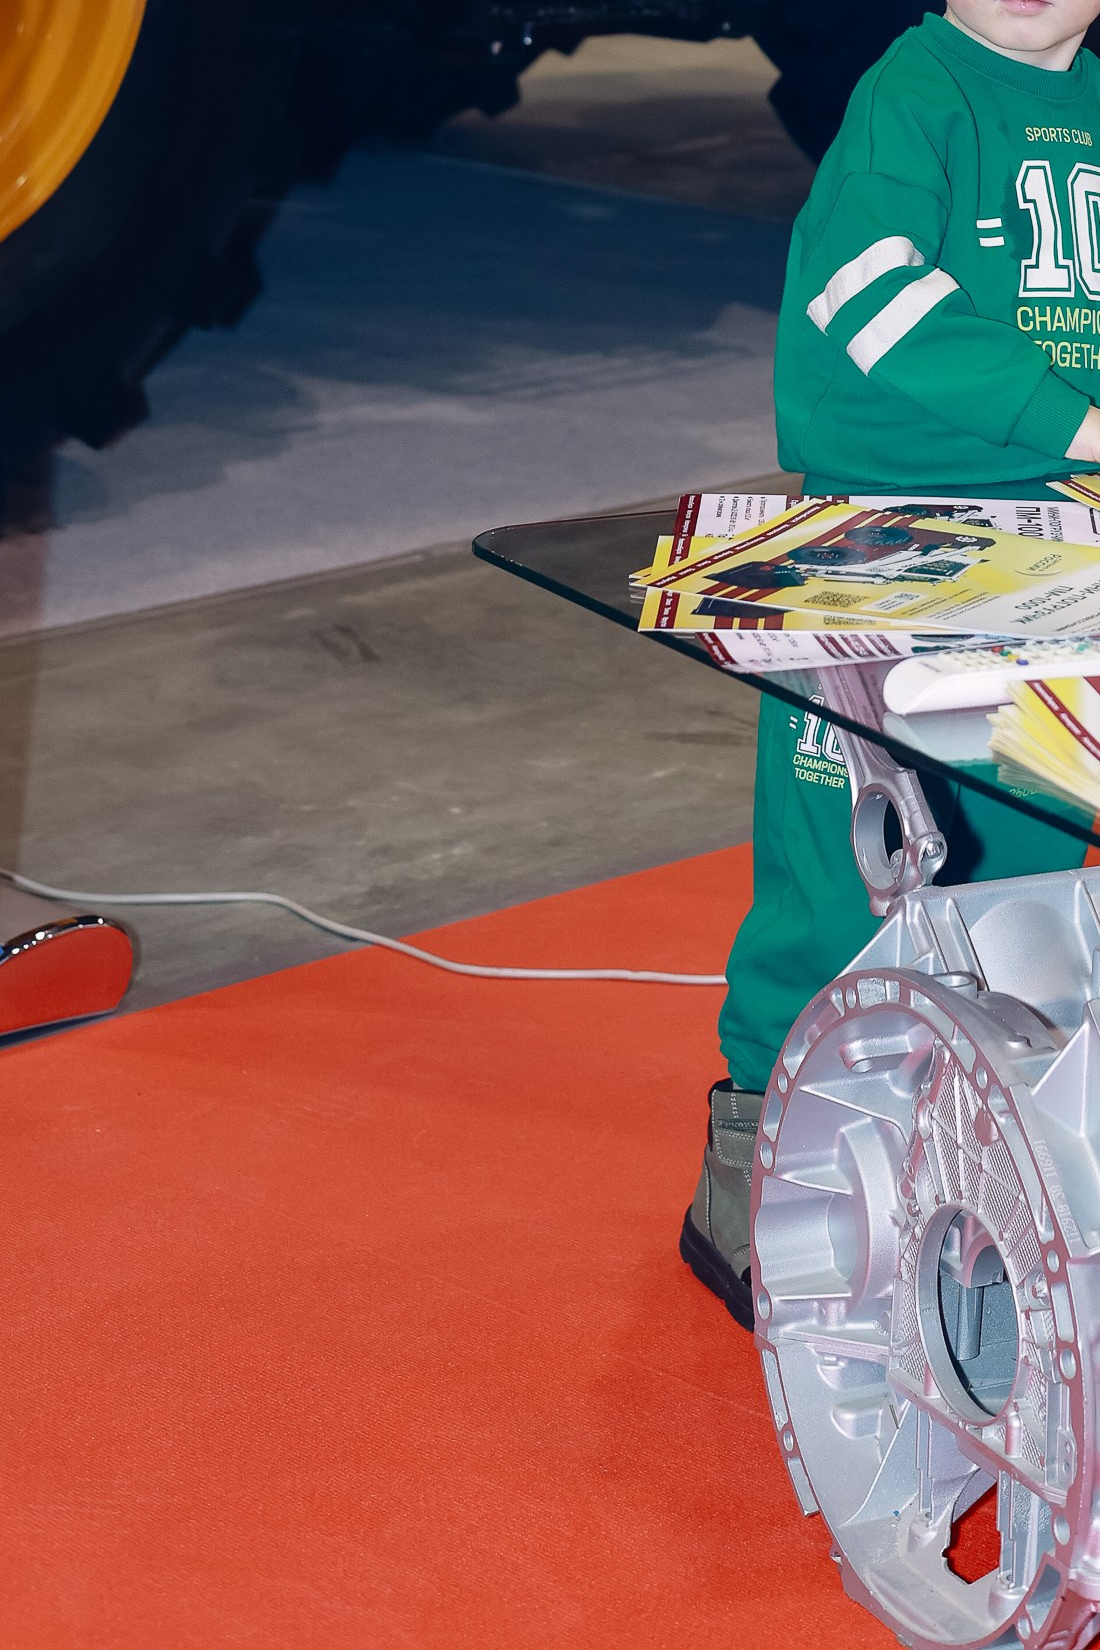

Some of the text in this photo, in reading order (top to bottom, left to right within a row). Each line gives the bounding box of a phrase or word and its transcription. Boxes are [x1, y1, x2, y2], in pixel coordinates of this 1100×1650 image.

[1025, 126, 1093, 146] SPORTS CLUB
[793, 754, 849, 778] CHAMPIONS
[795, 767, 845, 789] TOGETHER
